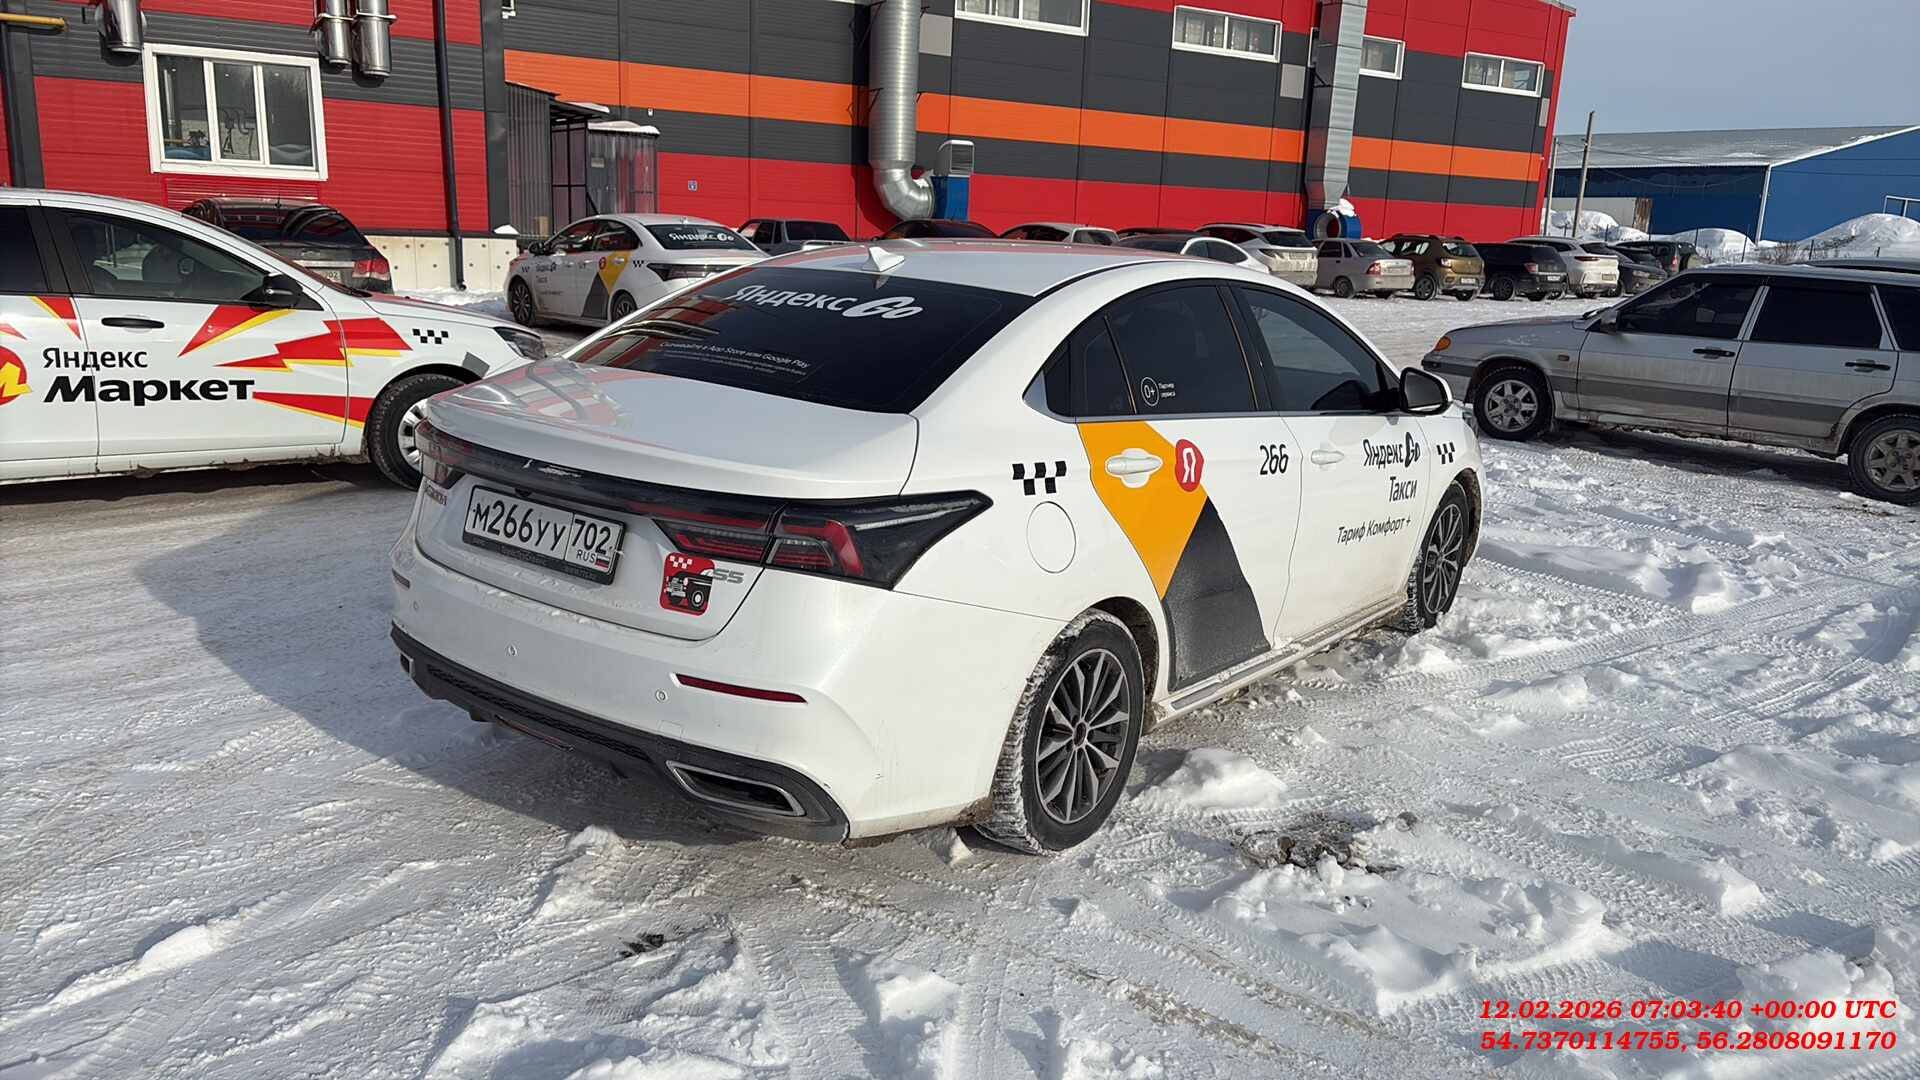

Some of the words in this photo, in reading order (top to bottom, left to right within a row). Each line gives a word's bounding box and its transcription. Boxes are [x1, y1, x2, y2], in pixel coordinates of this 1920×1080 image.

[735, 284, 858, 311] Яндекс
[842, 296, 923, 319] Go
[42, 347, 148, 371] Яндекс
[43, 375, 255, 406] Маркет
[1259, 443, 1289, 475] 266
[1362, 439, 1404, 469] Яндекс
[1404, 431, 1421, 468] Go
[1389, 476, 1418, 502] Такси
[571, 518, 611, 555] 702
[1337, 521, 1366, 545] Тариф
[1366, 516, 1406, 537] Комфорт
[576, 549, 596, 564] RUS
